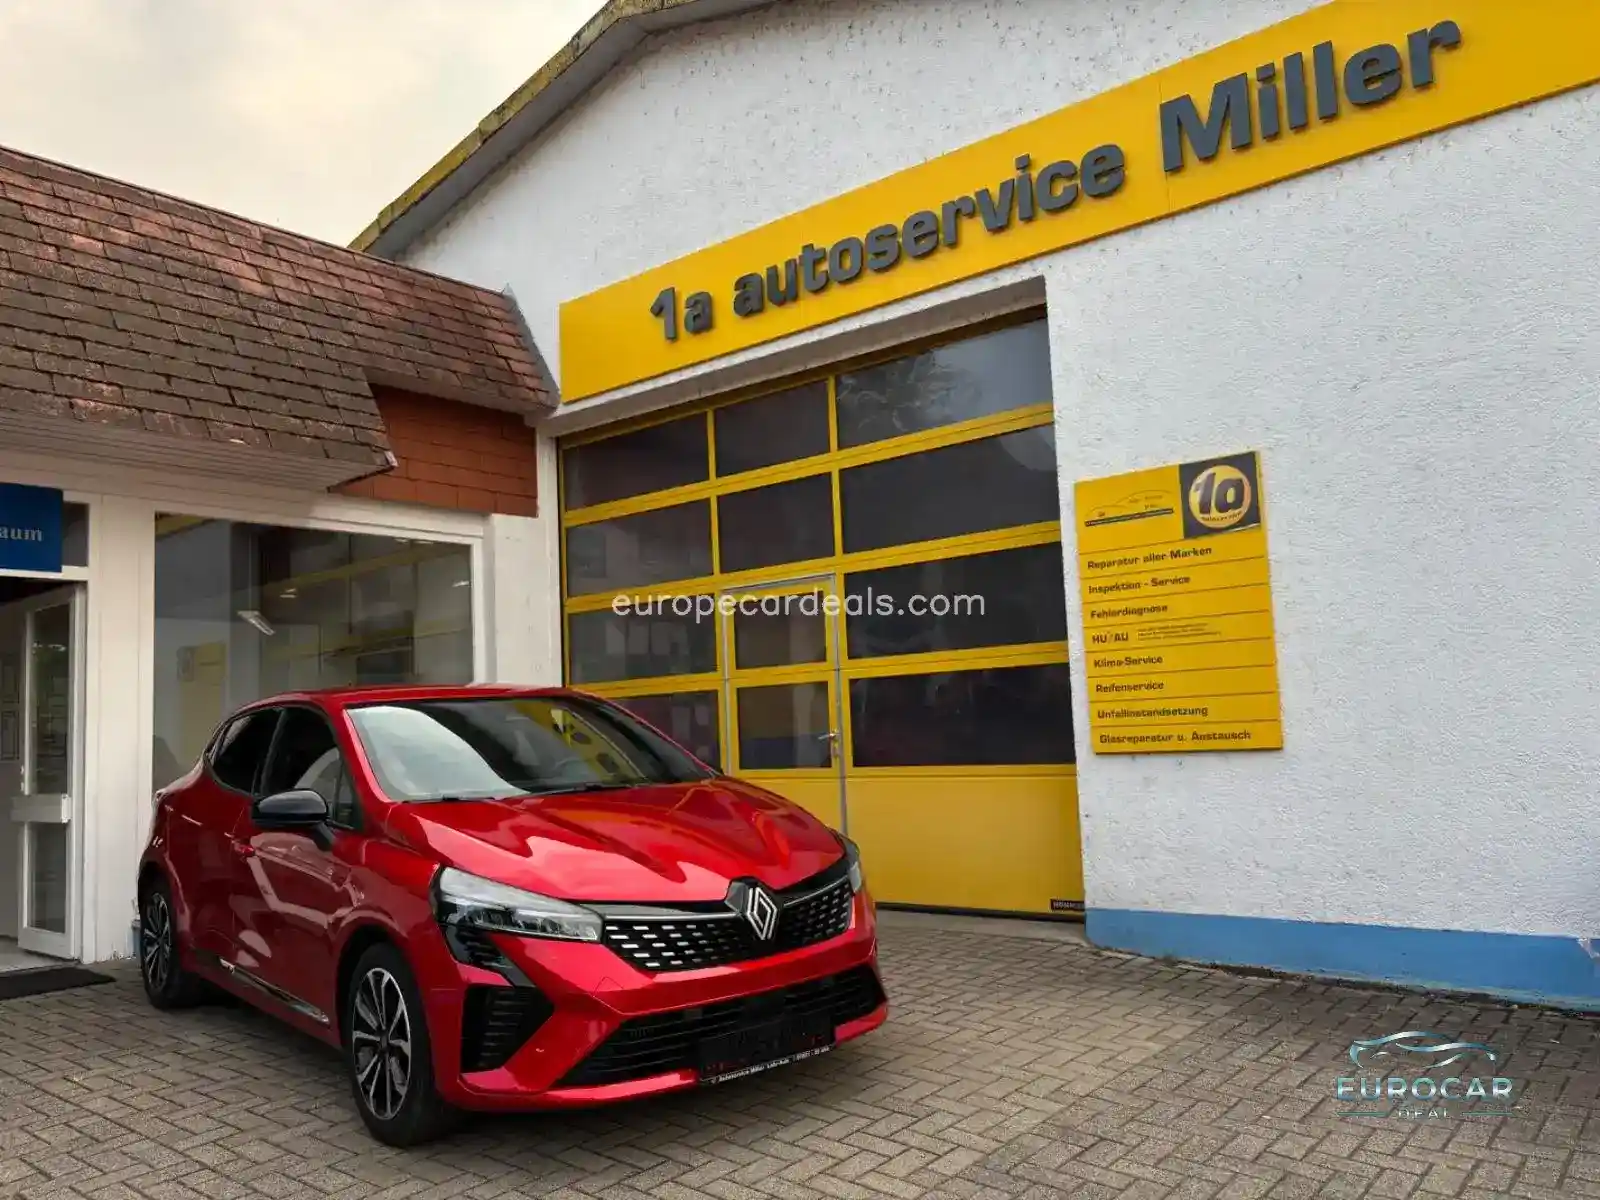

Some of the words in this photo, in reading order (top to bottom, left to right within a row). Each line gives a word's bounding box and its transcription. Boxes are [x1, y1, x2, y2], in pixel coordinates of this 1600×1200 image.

[649, 287, 713, 343] 1a
[732, 143, 1126, 317] autoservice
[1160, 20, 1462, 173] Miller
[1194, 472, 1245, 515] 1a
[1087, 556, 1140, 570] Reparatur
[1143, 552, 1167, 563] aller
[1170, 546, 1212, 560] Marken
[1088, 580, 1141, 595] Inspektion
[1151, 575, 1190, 587] Service
[1090, 604, 1168, 619] Fehlerdiagnose
[1094, 655, 1163, 668] Klima-Service
[1095, 681, 1164, 693] Reifenservice
[1097, 705, 1208, 719] Unfallinstandsetzung
[1099, 732, 1173, 745] Glasreparatur
